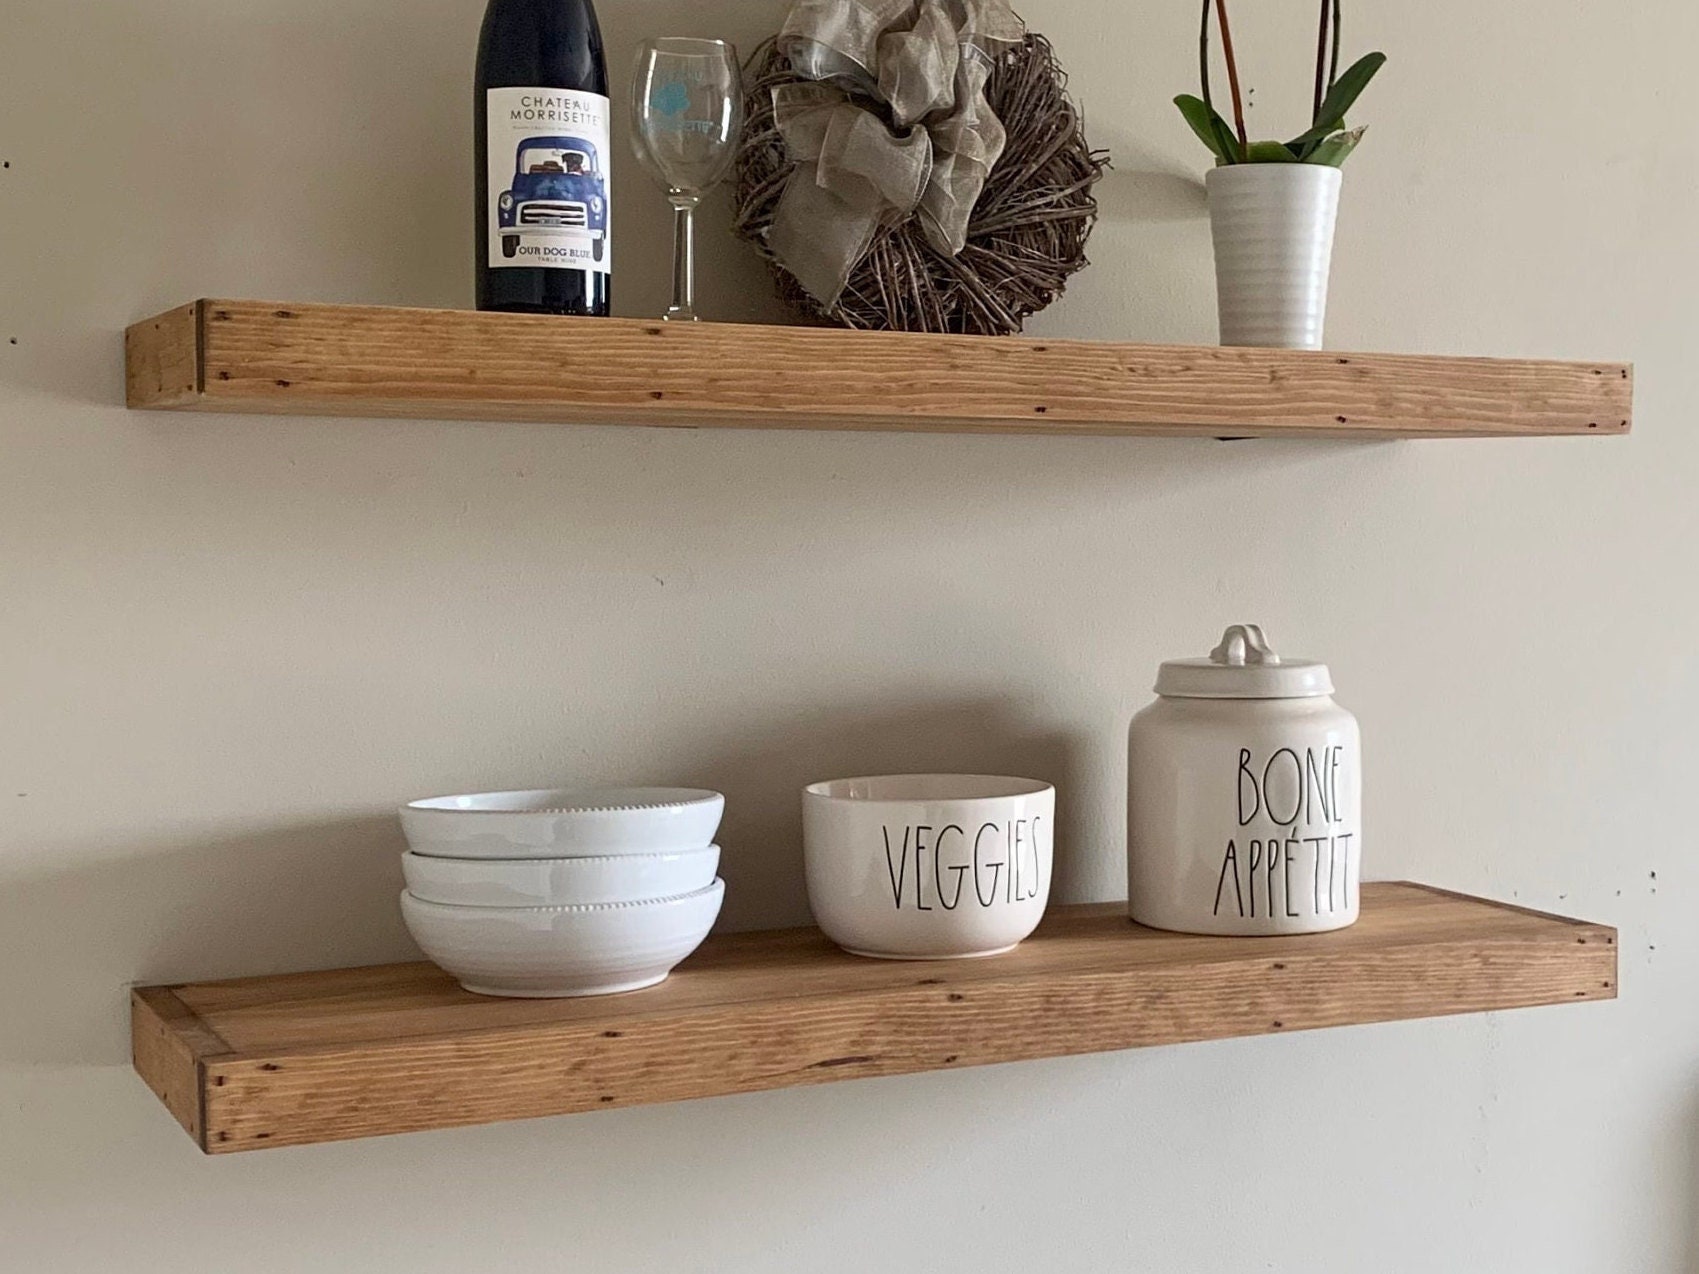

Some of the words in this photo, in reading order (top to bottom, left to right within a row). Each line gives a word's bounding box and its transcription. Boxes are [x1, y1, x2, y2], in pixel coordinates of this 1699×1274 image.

[510, 109, 598, 126] MORRISETTE
[520, 96, 590, 112] CHATEAU
[519, 246, 541, 255] OUR
[543, 247, 567, 257] DOG
[569, 248, 591, 259] BLUE
[1238, 746, 1343, 826] BONE
[882, 816, 1041, 911] VEGGIES
[1213, 826, 1353, 918] APPÉTIT
